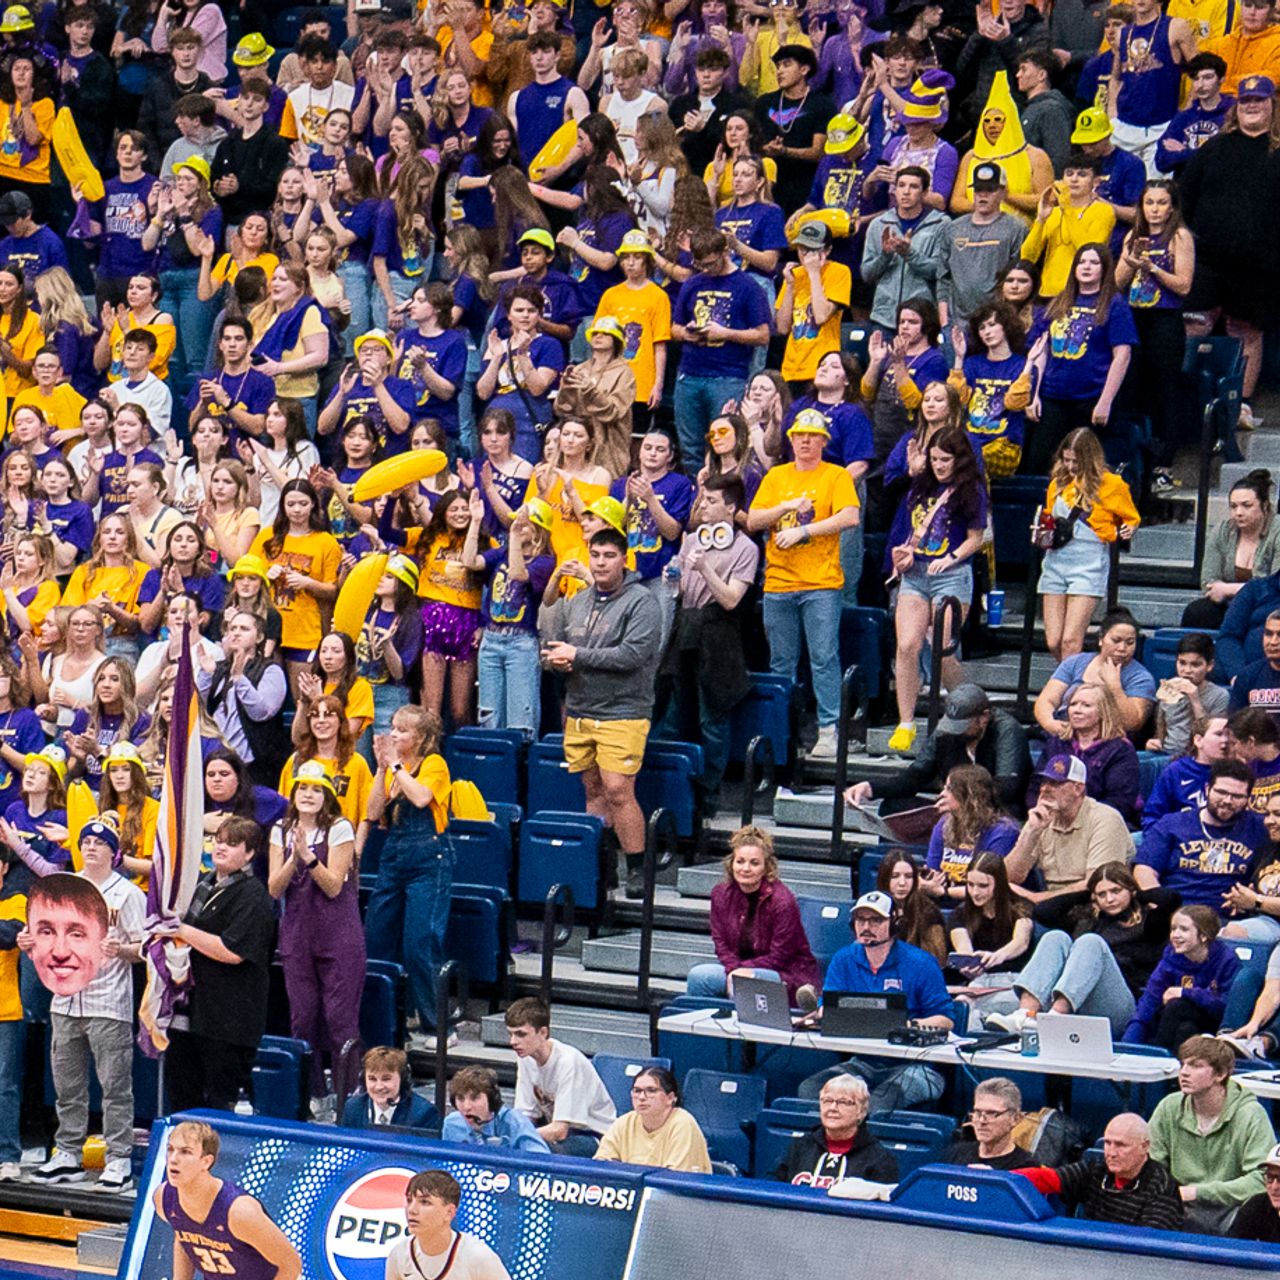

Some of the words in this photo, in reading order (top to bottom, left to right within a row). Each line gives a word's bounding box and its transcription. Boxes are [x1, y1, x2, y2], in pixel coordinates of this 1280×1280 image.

[1179, 839, 1253, 860] LEWISTON
[473, 1170, 510, 1193] GO
[516, 1174, 636, 1211] WARRIORS!
[947, 1184, 977, 1202] POSS
[174, 1230, 233, 1253] LEWISTON
[334, 1214, 409, 1246] PEP
[191, 1246, 236, 1274] 33
